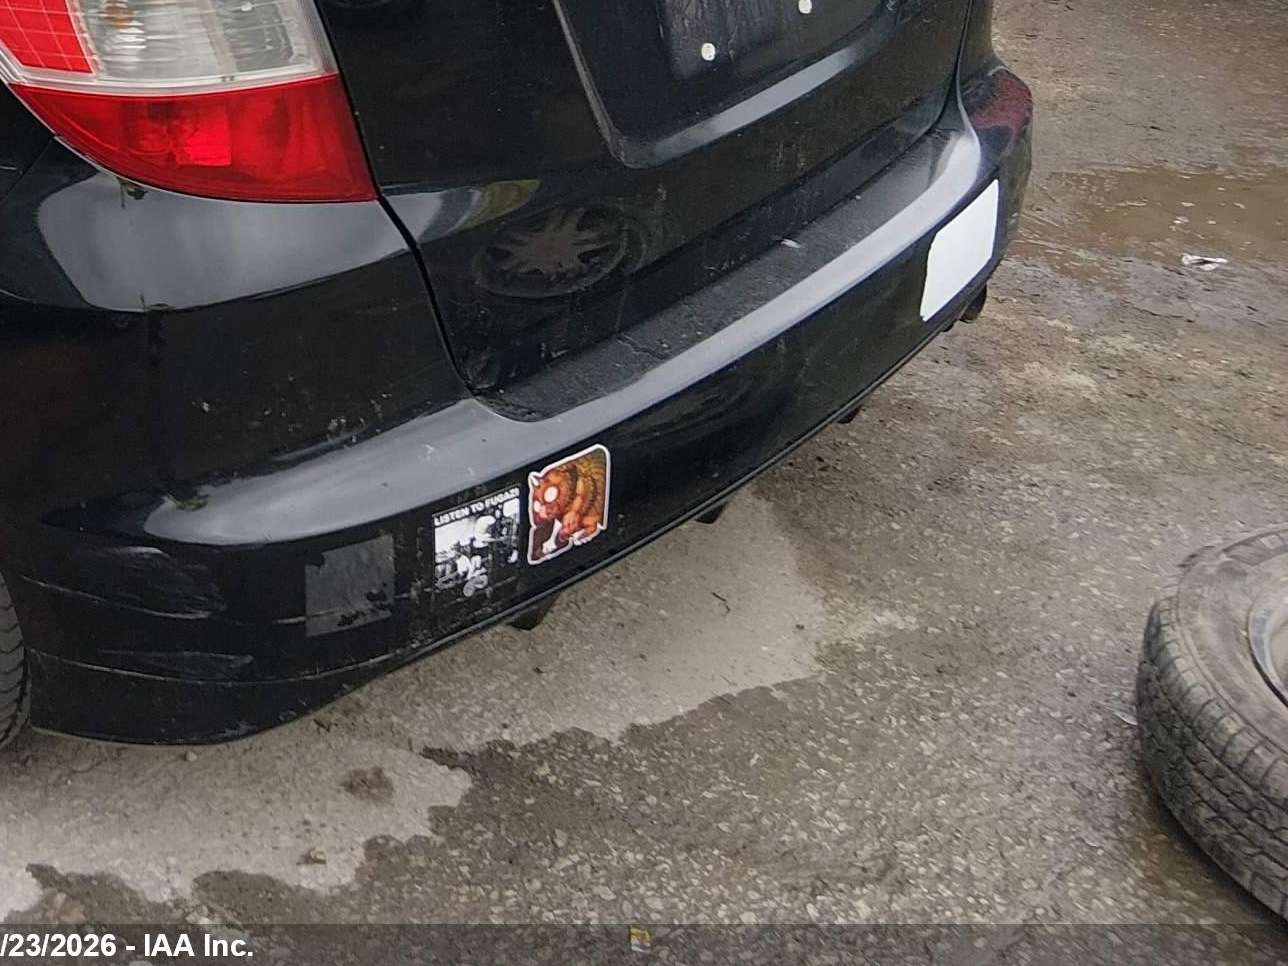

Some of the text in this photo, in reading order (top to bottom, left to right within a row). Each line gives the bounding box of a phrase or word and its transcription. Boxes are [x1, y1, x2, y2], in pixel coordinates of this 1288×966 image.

[434, 487, 520, 526] LISTEN TO FUGAZI
